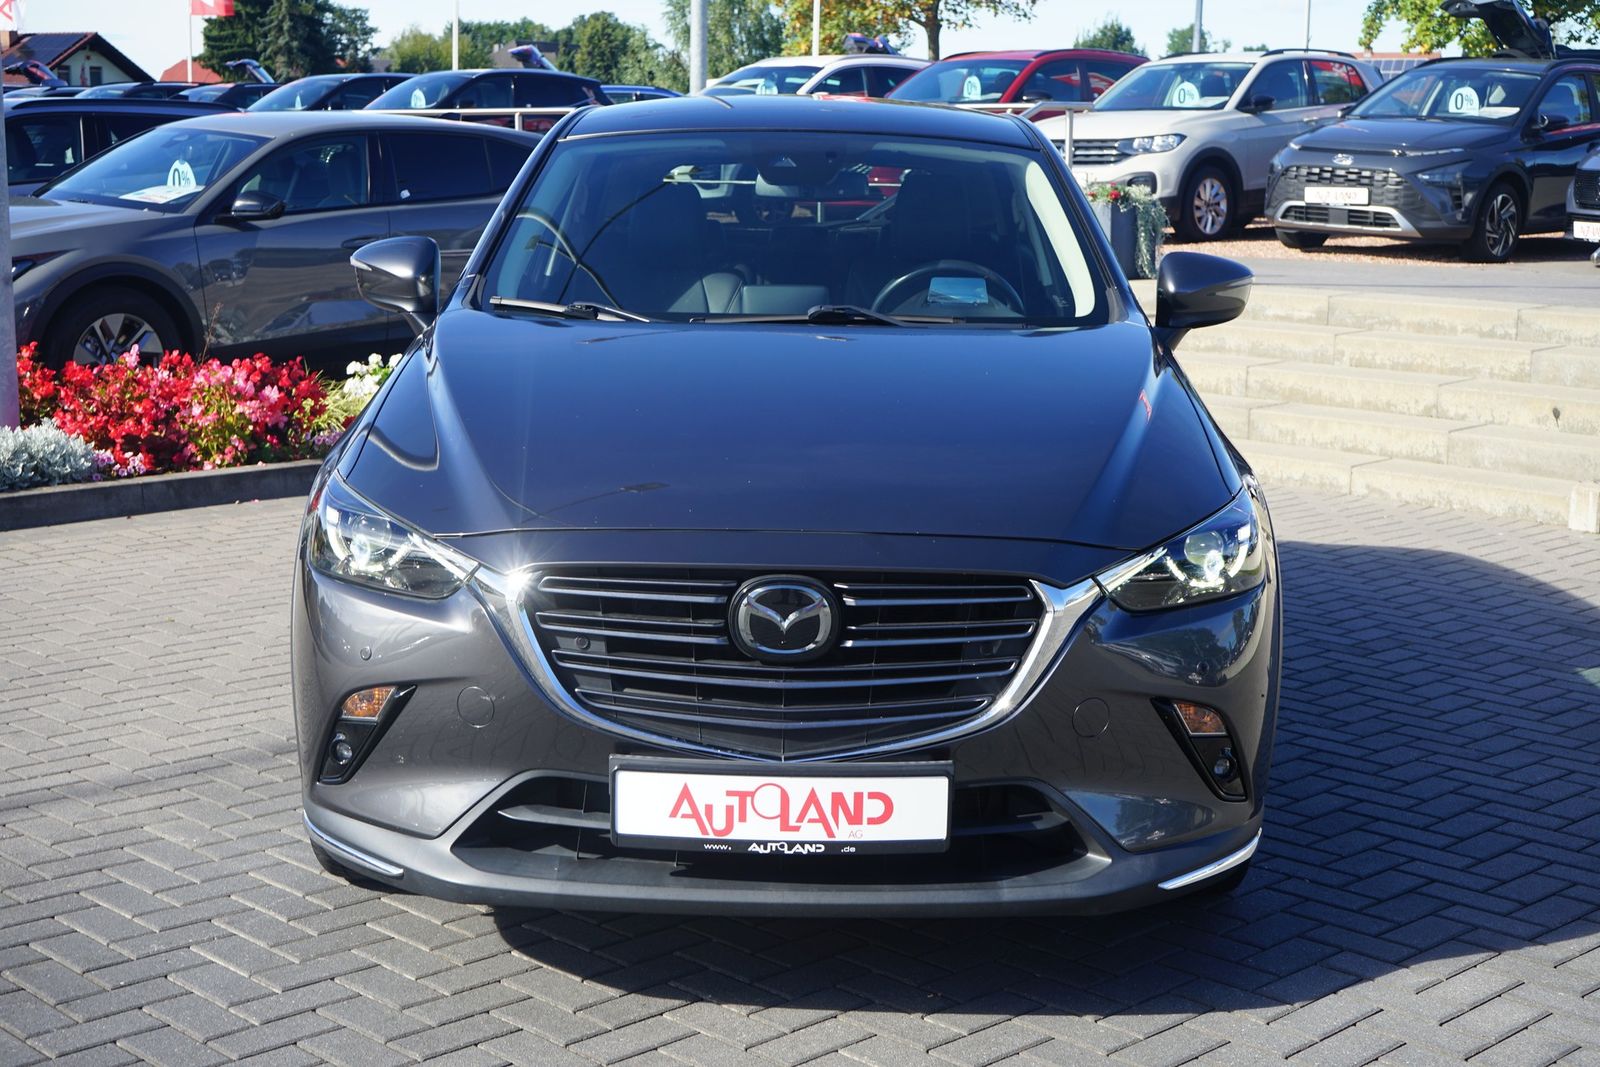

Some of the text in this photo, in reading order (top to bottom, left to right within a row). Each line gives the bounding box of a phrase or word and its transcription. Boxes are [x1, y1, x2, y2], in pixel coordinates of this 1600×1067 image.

[1455, 93, 1473, 110] 0%
[669, 782, 894, 838] AUTOLAND
[848, 830, 863, 839] AG
[748, 841, 825, 854] AUTOLAND
